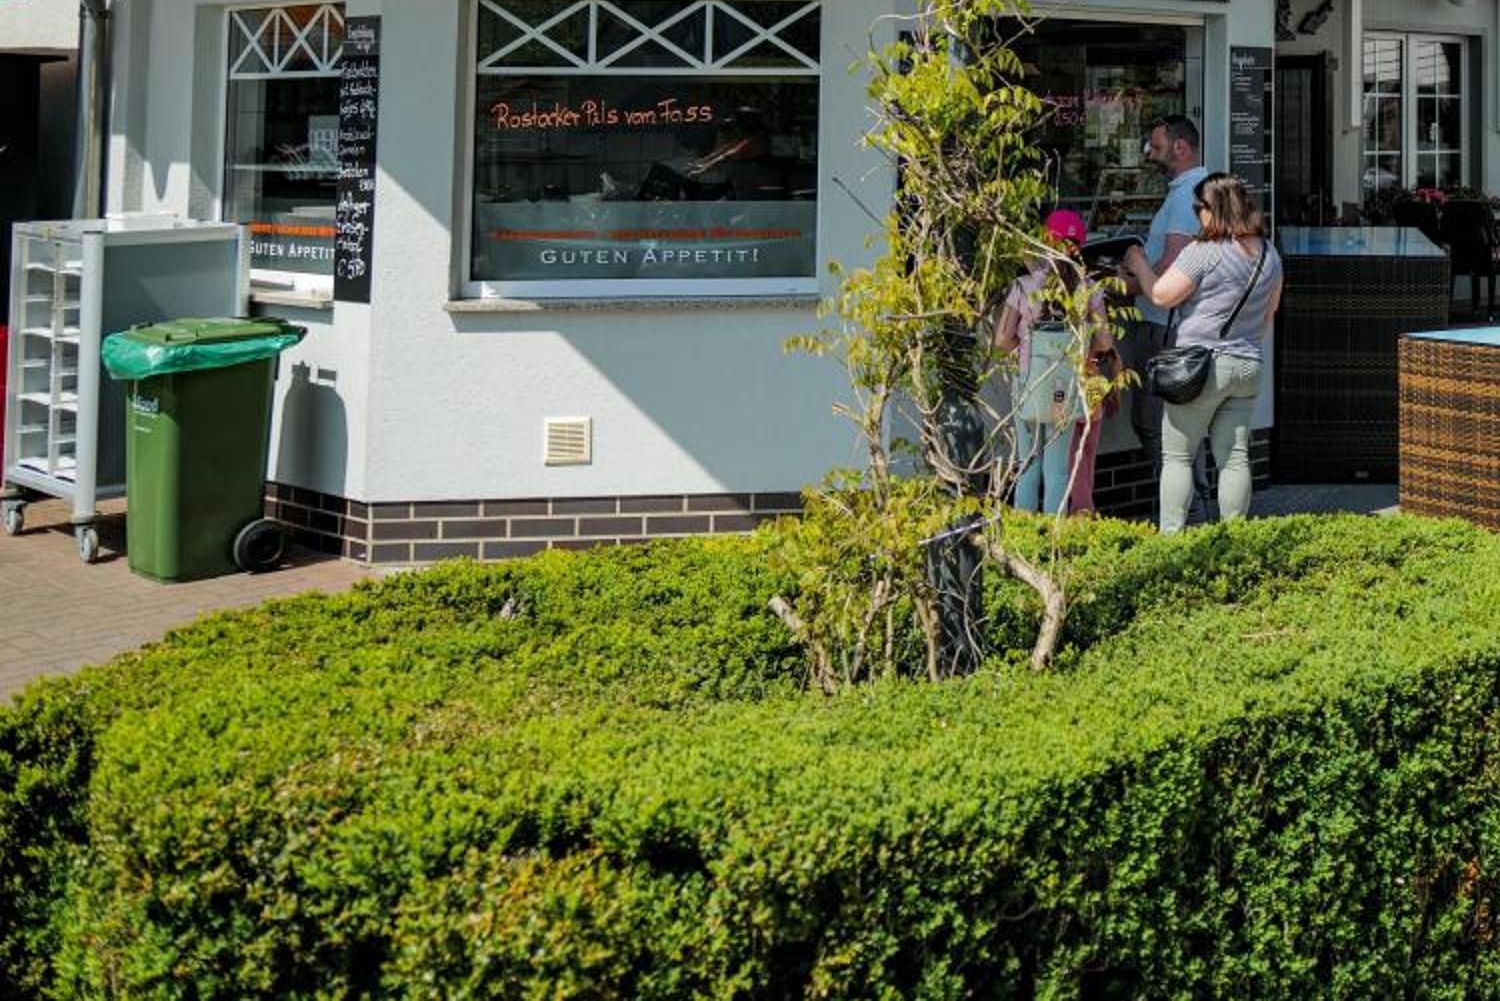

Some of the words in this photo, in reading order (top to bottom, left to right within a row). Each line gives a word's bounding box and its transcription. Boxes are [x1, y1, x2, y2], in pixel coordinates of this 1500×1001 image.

[657, 98, 714, 125] Fass
[541, 249, 627, 264] GUTEN
[643, 245, 760, 264] APPETIT!
